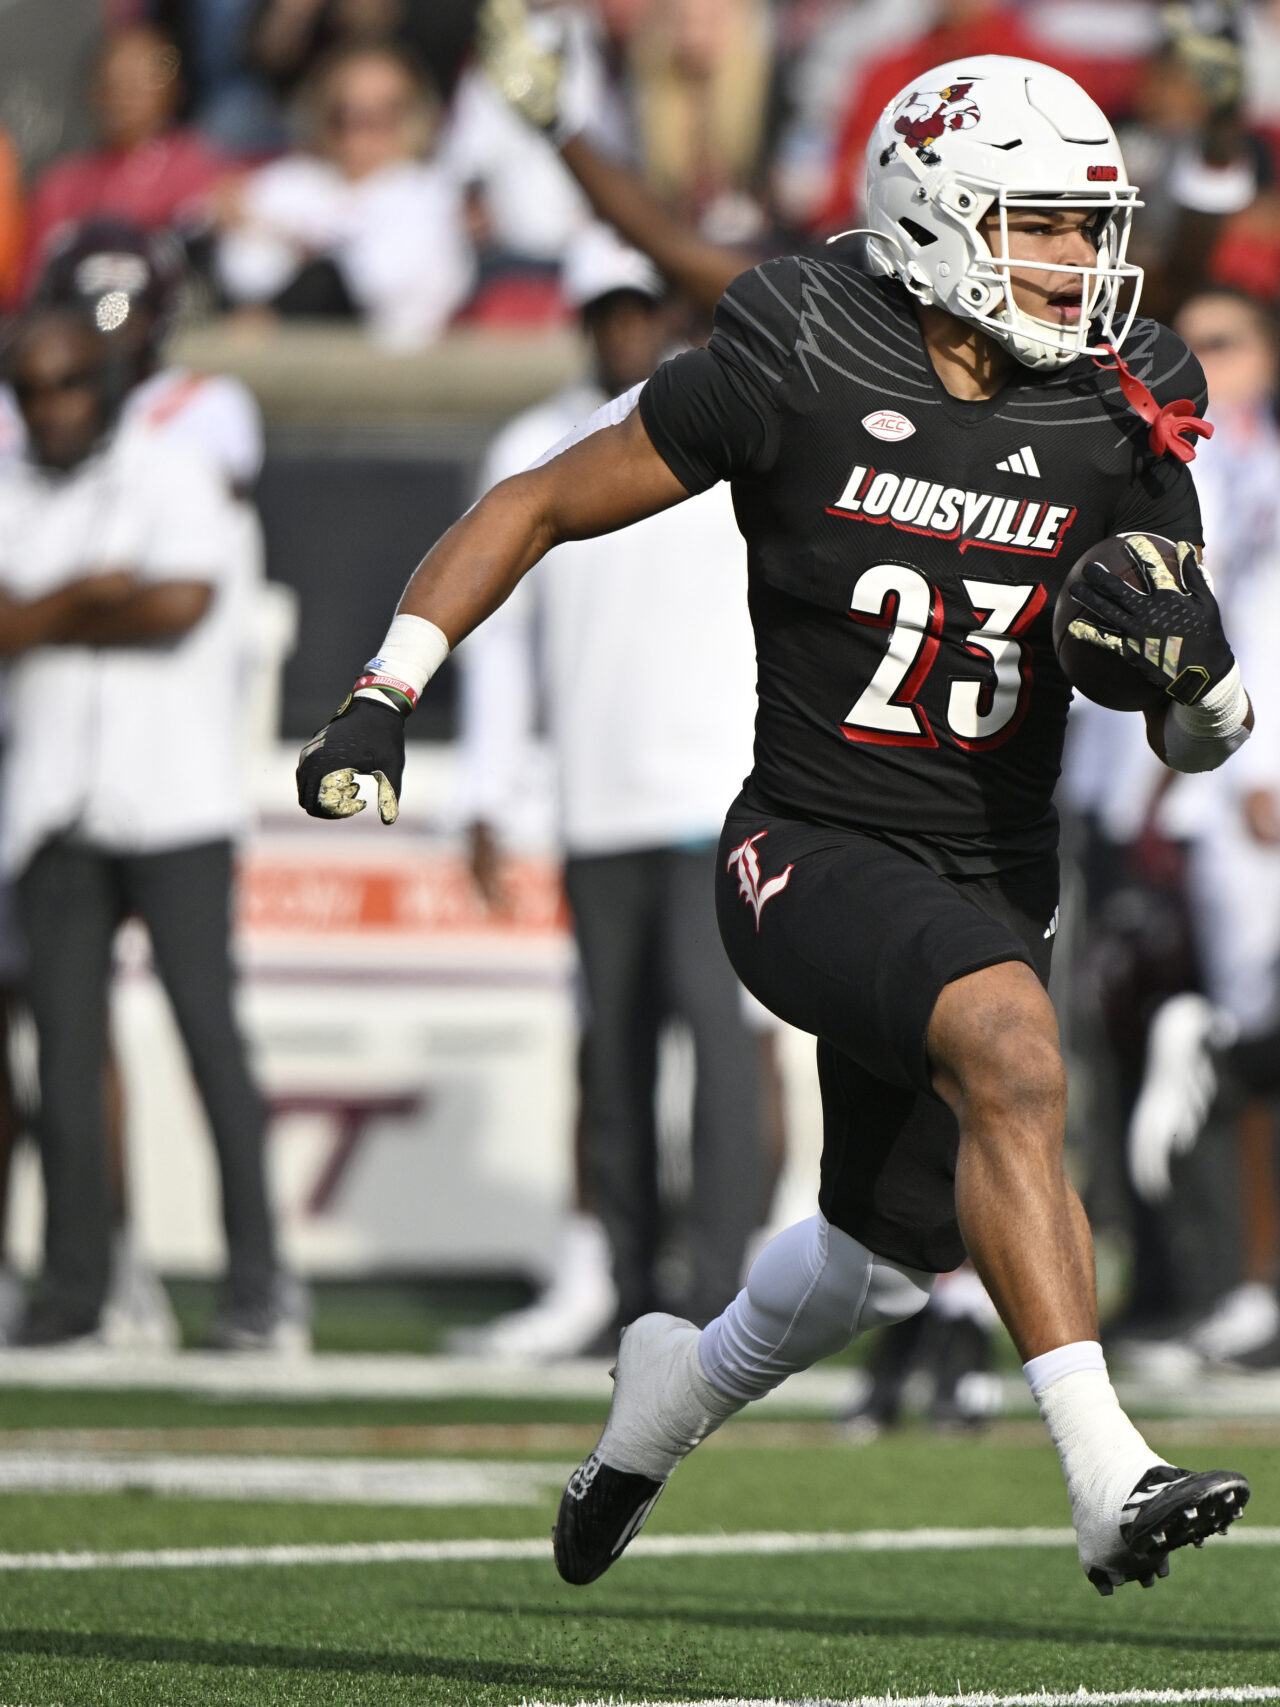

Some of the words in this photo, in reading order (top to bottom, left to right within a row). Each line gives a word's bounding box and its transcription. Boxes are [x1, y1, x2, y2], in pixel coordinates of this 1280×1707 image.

[871, 418, 906, 431] ACC
[825, 464, 1077, 558] LOUISVILLE
[837, 560, 1048, 752] 23
